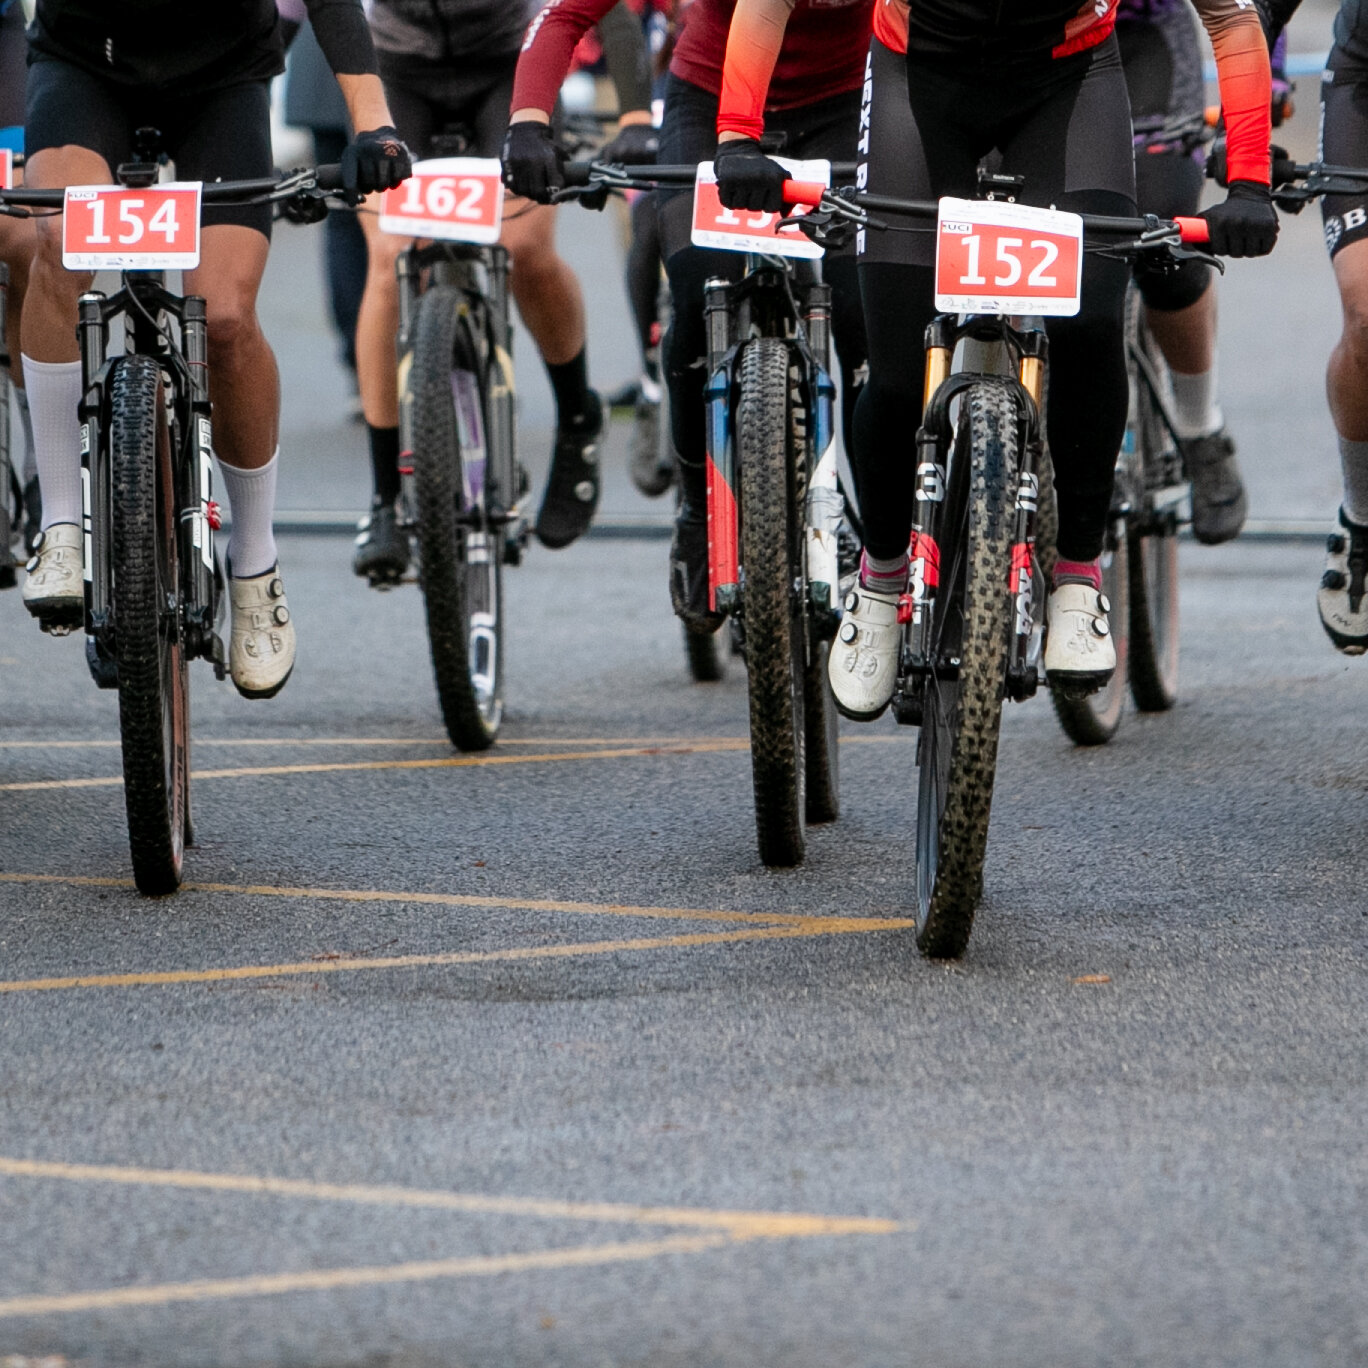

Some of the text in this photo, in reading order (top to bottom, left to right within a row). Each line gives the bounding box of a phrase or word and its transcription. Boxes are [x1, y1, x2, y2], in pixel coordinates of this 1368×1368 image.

[399, 176, 486, 220] 162
[85, 198, 181, 245] 154
[947, 224, 970, 232] UCI
[959, 234, 1060, 287] 152
